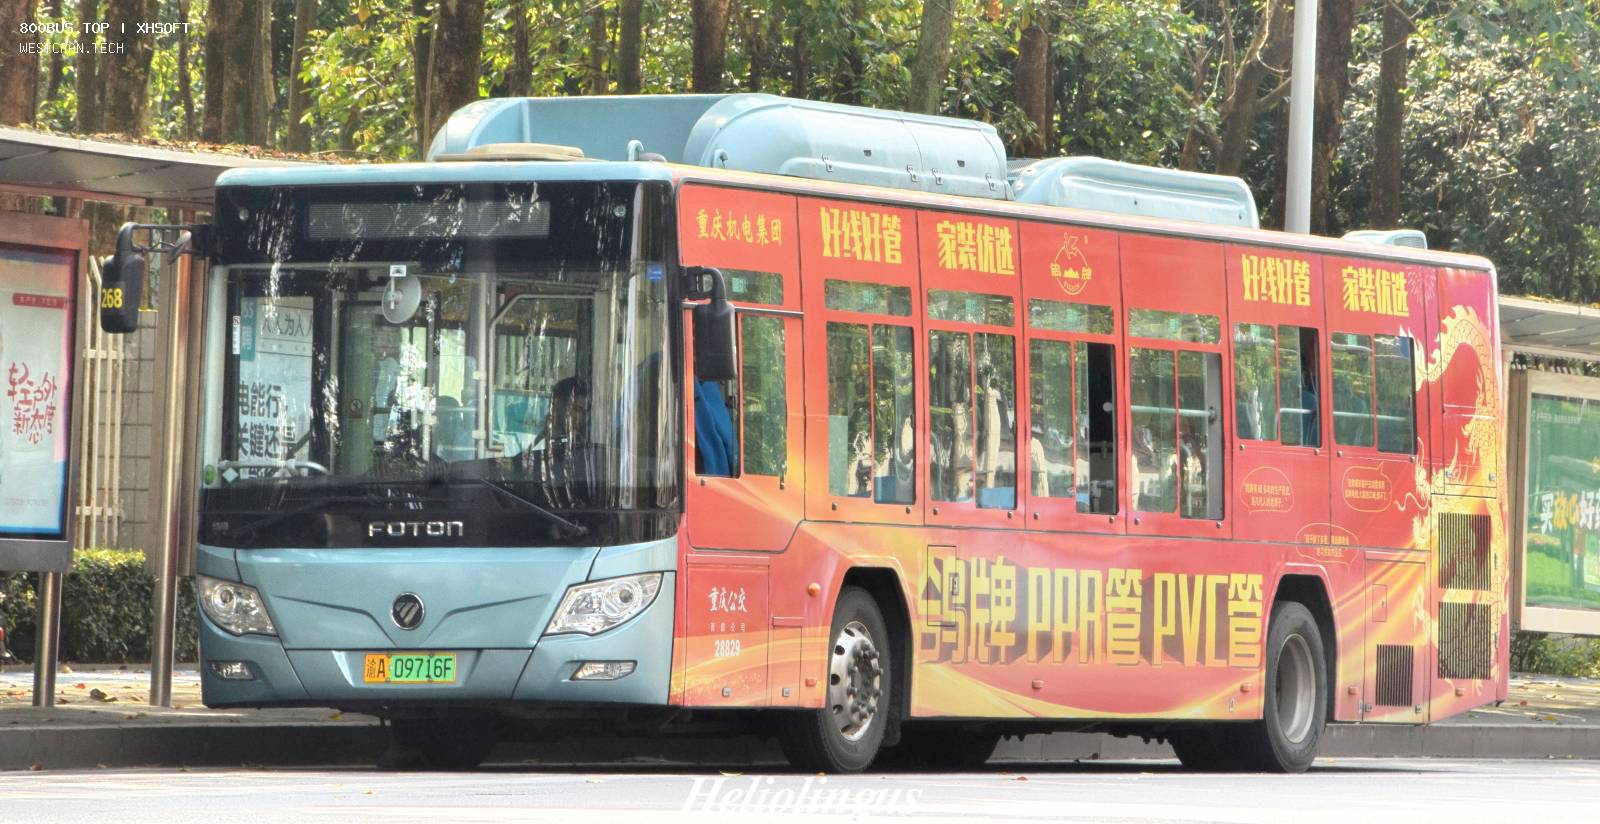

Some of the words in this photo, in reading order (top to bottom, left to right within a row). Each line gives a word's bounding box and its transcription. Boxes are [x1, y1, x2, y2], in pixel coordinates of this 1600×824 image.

[696, 208, 782, 246] 重庆机电集团
[820, 206, 902, 264] 好线好管
[936, 219, 1015, 276] 家装优选
[101, 287, 123, 308] 268
[1241, 253, 1311, 307] 好线好管
[1341, 265, 1410, 317] 家装优选
[367, 520, 464, 538] FOTON
[708, 585, 748, 613] 重庆公交
[1152, 572, 1264, 669] PVC管
[714, 639, 741, 657] 28829
[394, 657, 453, 679] 09716F
